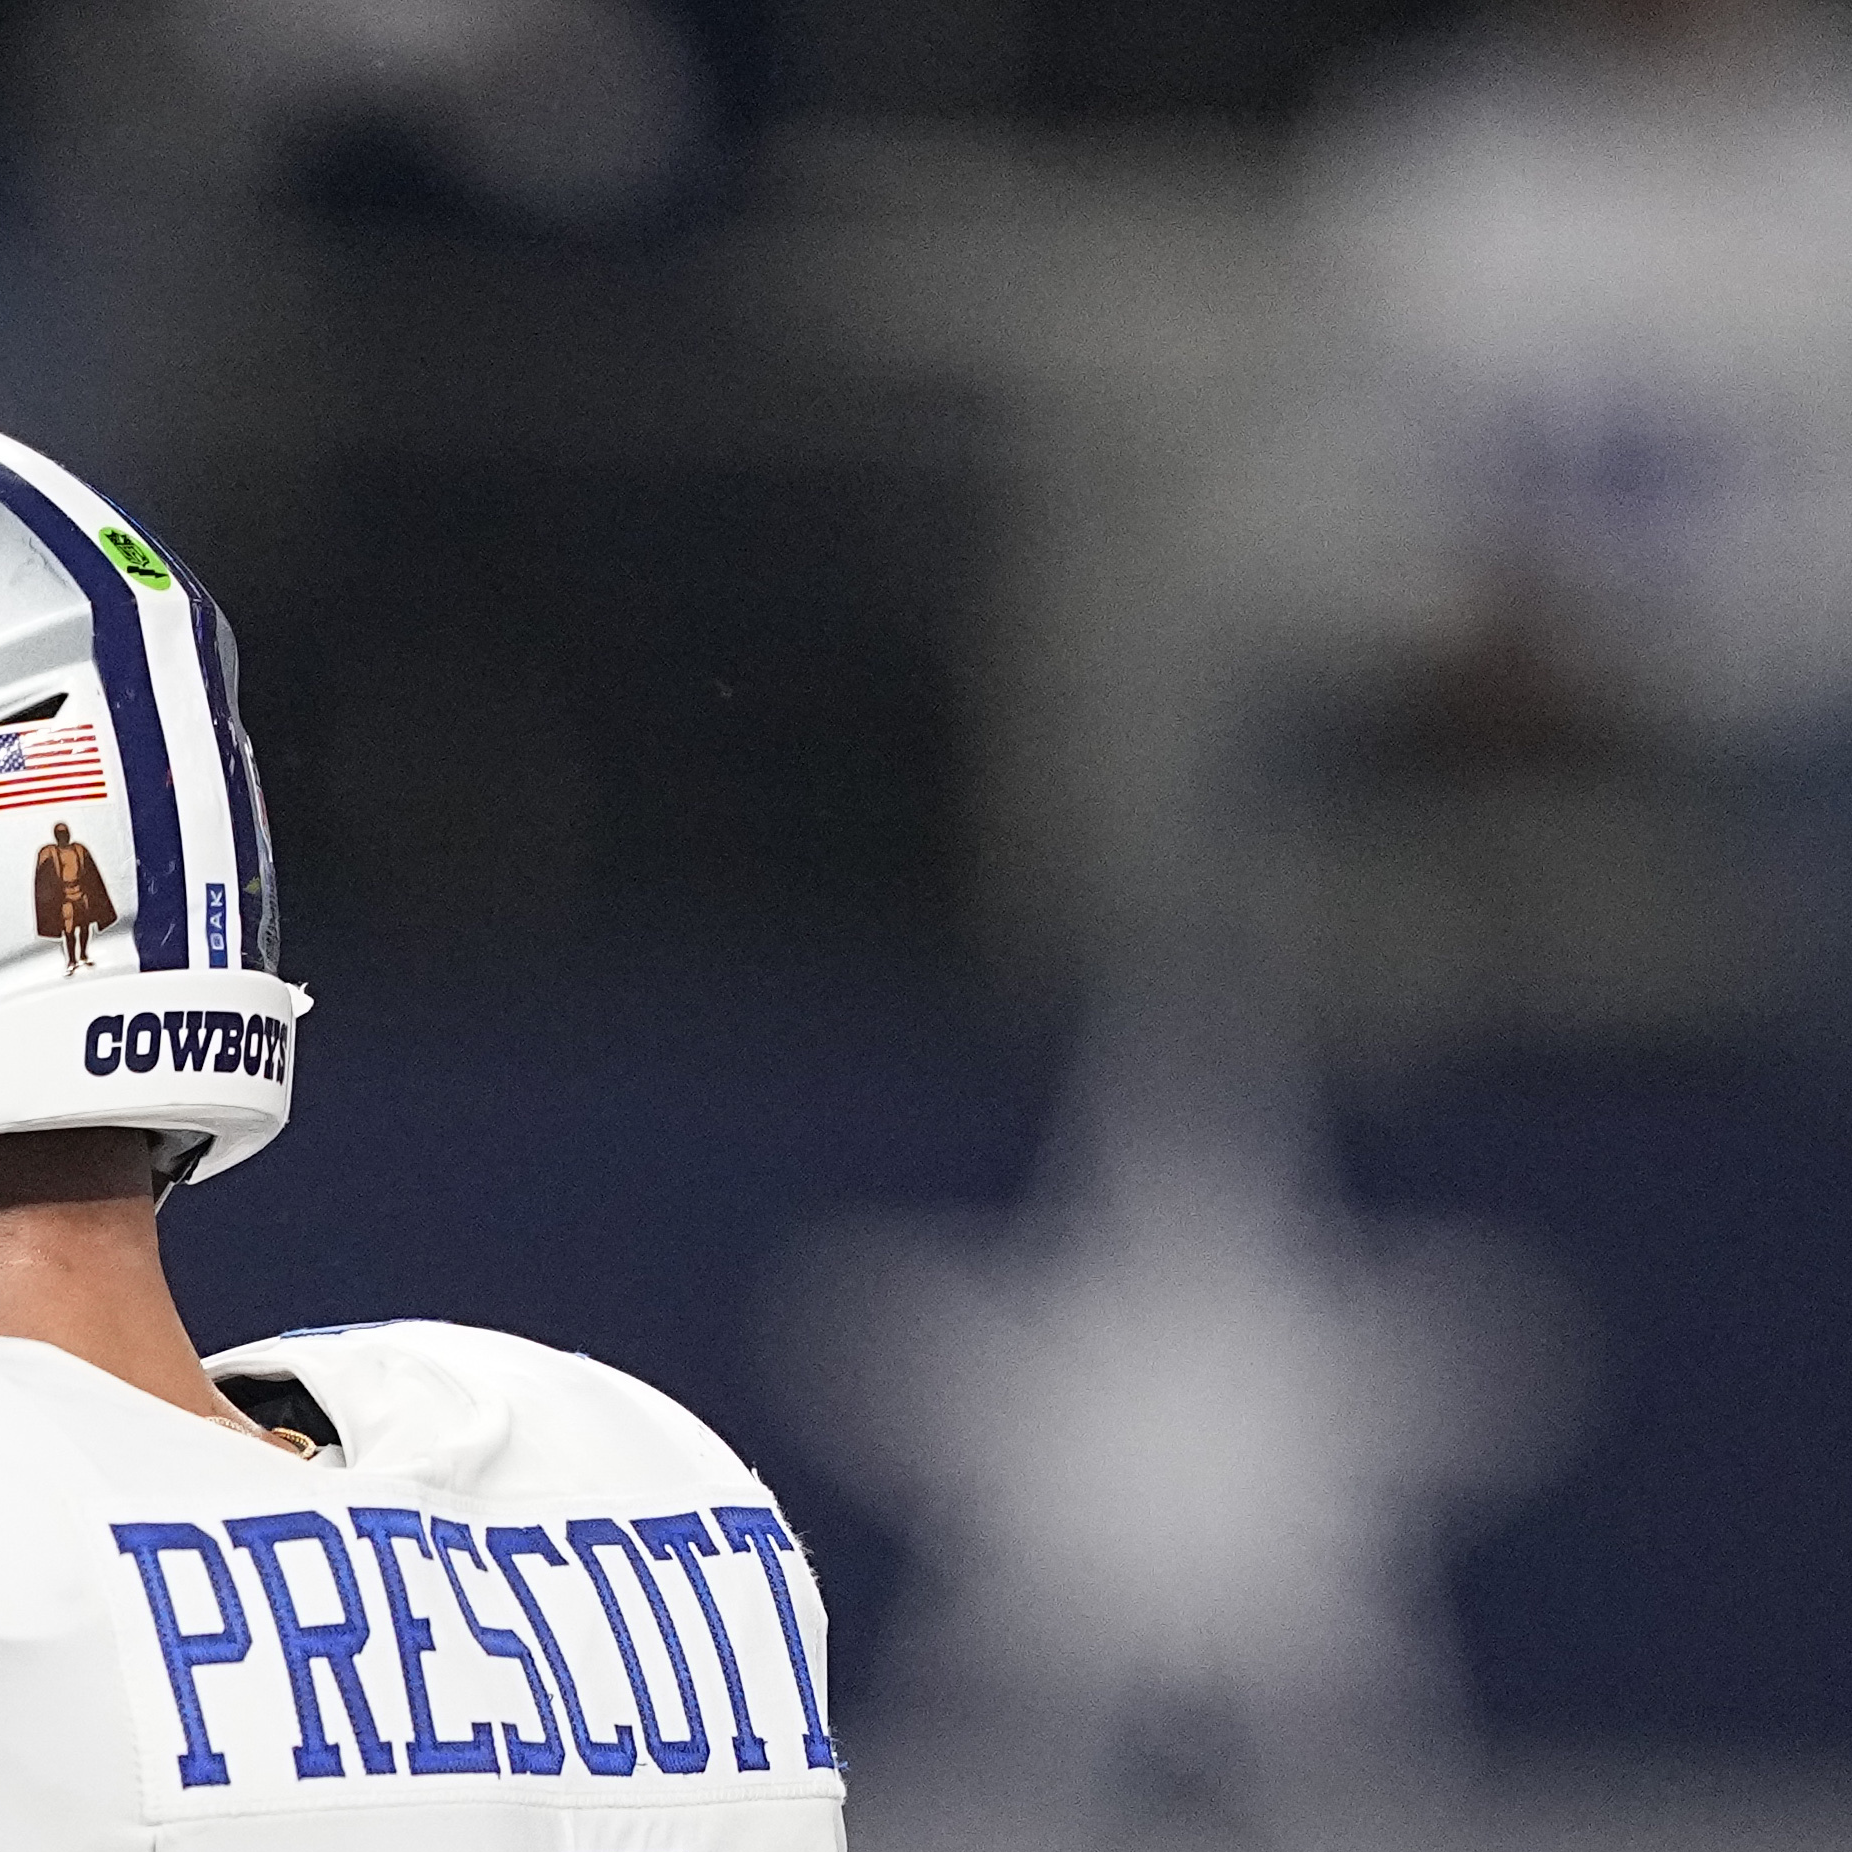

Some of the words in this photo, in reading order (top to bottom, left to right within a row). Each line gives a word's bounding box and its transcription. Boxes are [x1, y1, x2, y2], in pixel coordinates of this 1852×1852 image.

[209, 889, 226, 951] DAK
[84, 1010, 289, 1087] COWBOYS
[109, 1506, 838, 1790] PRESCOTT
